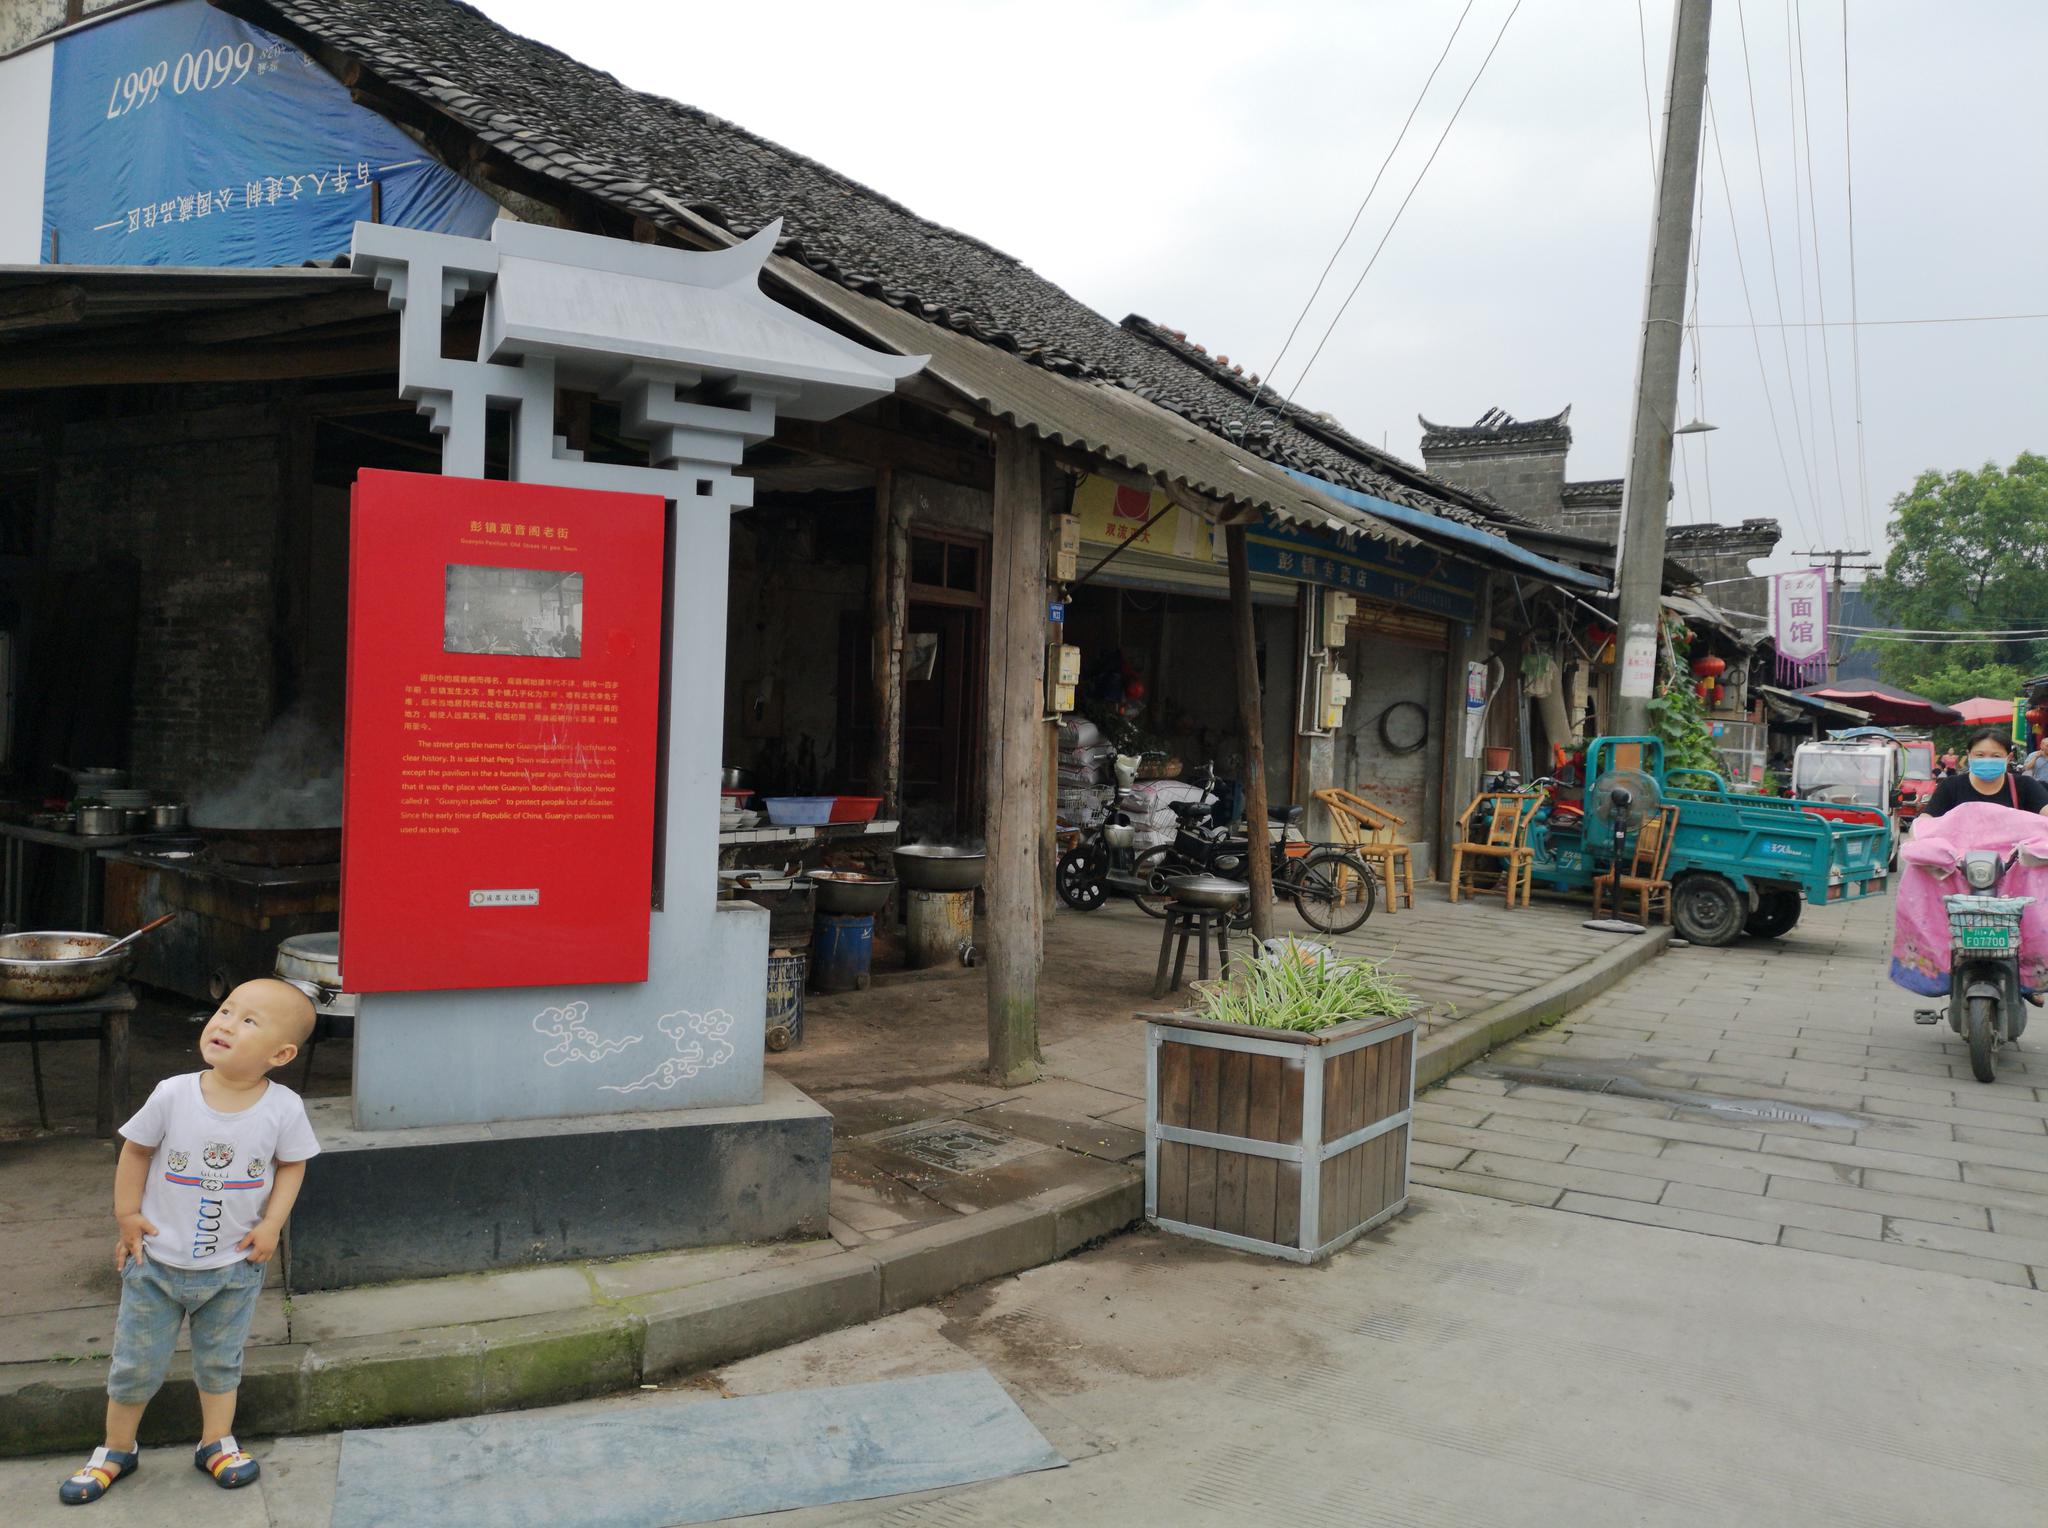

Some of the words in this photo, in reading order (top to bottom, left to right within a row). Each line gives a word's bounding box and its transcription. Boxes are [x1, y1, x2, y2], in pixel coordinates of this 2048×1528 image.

[173, 42, 254, 94] 6600
[107, 60, 168, 120] 6667
[246, 161, 373, 209] 百年人文建制
[127, 187, 234, 233] 公园藏品住区
[470, 520, 569, 539] 彭镇观音阁老街
[1789, 597, 1814, 643] 面馆
[402, 754, 420, 762] clear
[497, 756, 514, 764] Peng
[418, 740, 431, 748] The
[455, 742, 470, 750] gets
[402, 769, 426, 777] except
[441, 769, 470, 778] pavilion
[457, 784, 475, 792] place
[501, 784, 529, 793] Guanyin
[400, 811, 420, 819] Since
[437, 812, 453, 820] early
[481, 812, 512, 820] Republic
[544, 812, 573, 820] Guanyin
[192, 1196, 223, 1259] GUCCI
